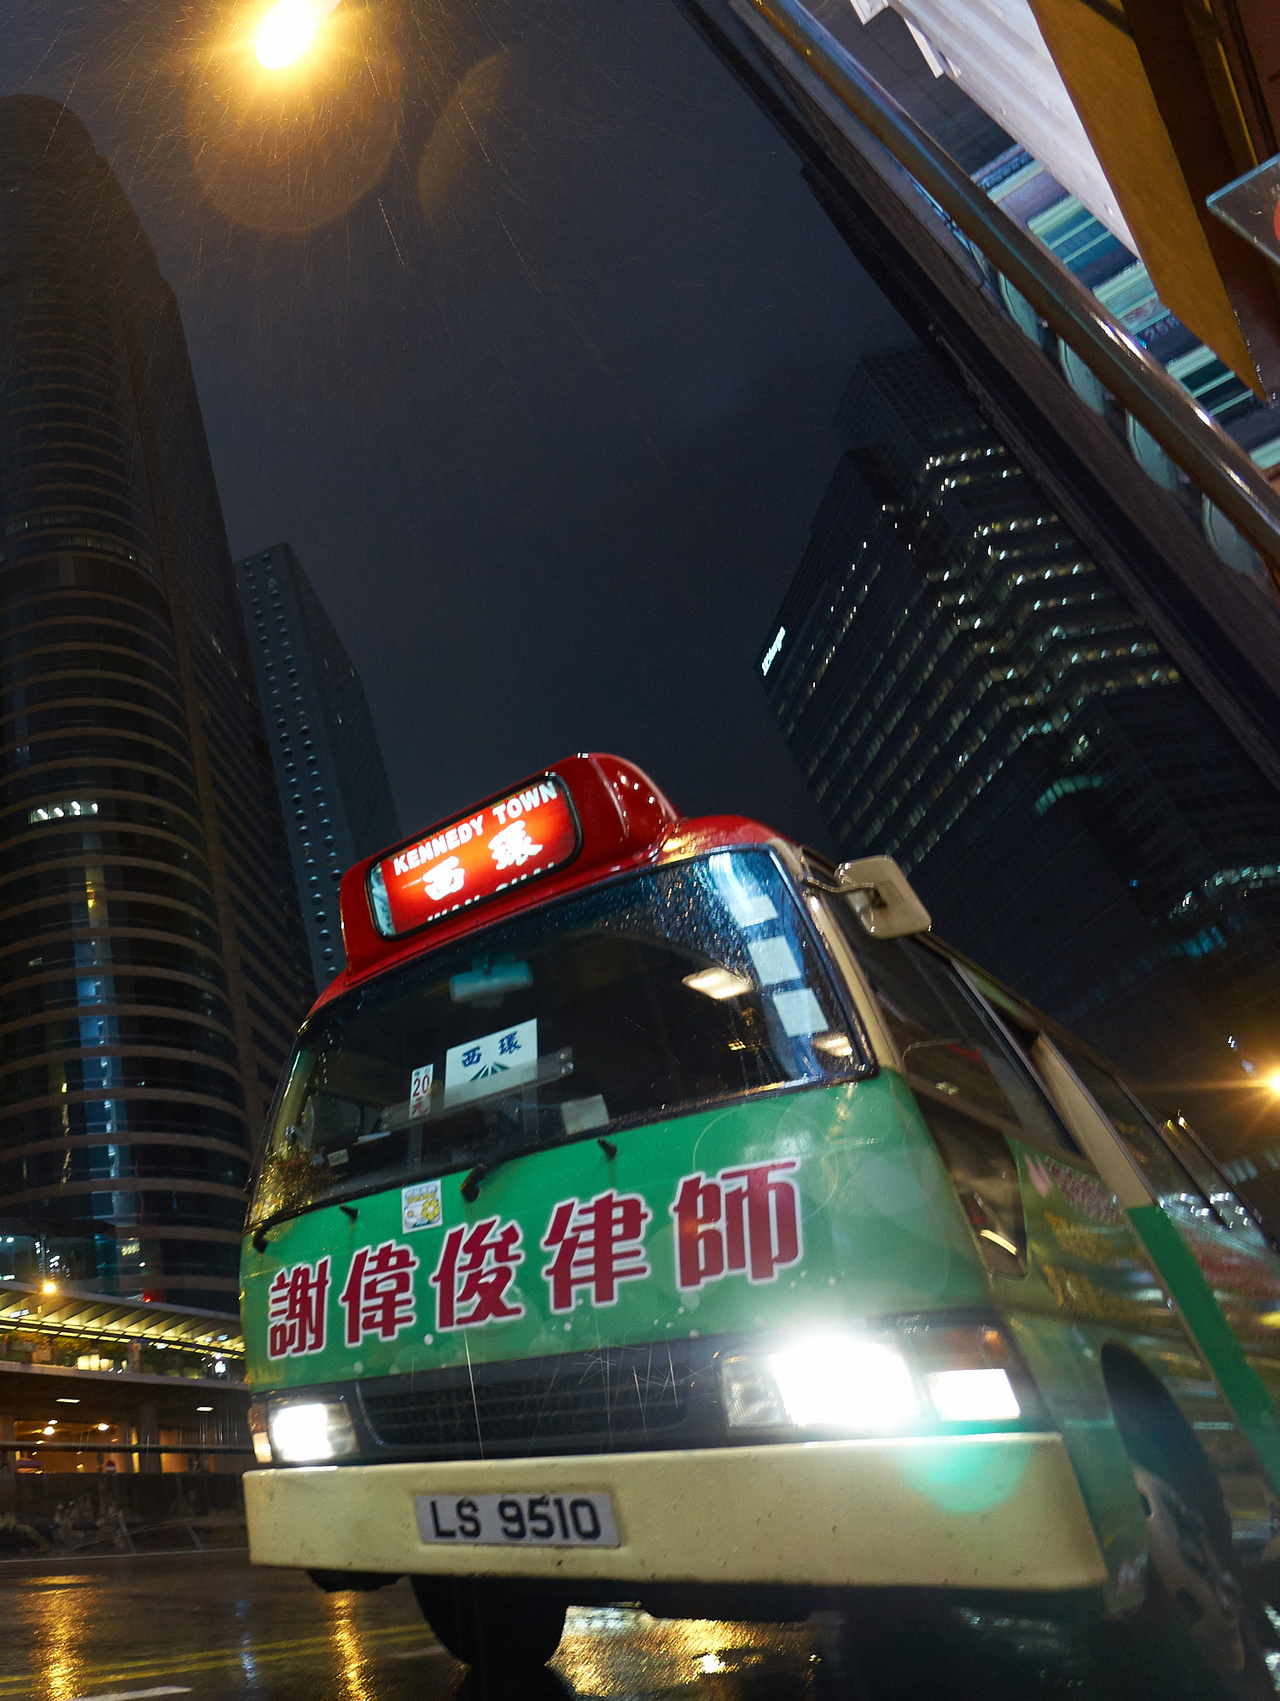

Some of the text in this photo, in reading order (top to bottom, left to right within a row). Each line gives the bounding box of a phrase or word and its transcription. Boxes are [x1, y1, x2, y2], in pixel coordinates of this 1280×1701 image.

[393, 780, 558, 876] KENNEDY TOWN
[461, 1030, 523, 1068] 西環
[412, 1074, 430, 1098] 20
[268, 1158, 802, 1360] 謝偉俊律師
[429, 1497, 602, 1541] LS 9510
